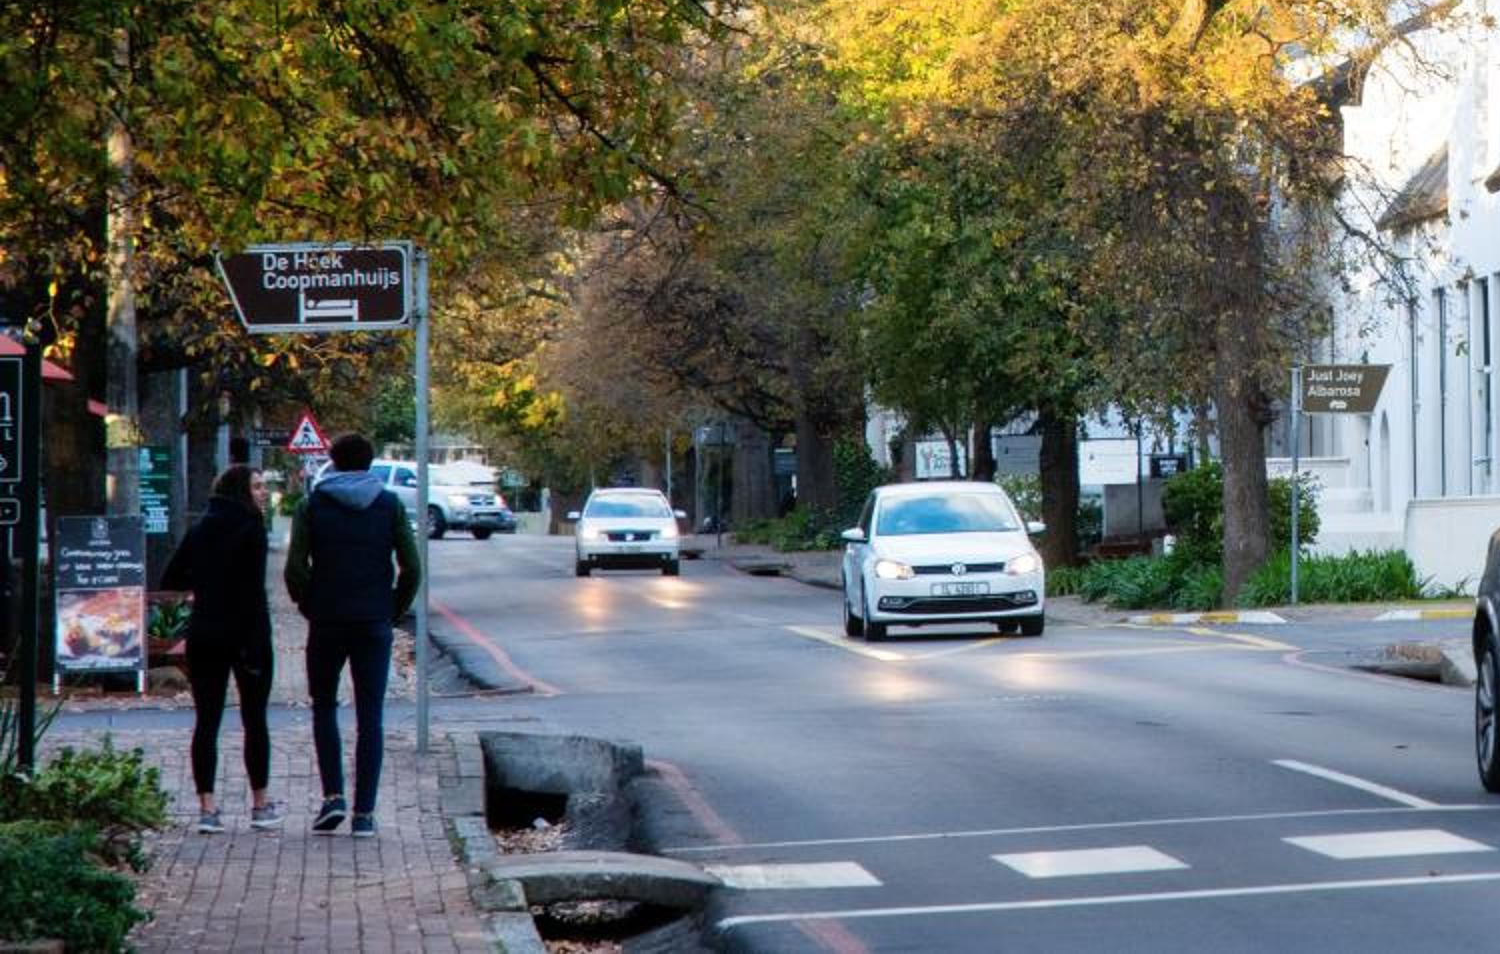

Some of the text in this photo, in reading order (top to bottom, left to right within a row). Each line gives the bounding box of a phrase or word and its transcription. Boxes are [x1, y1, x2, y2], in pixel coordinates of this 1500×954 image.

[263, 252, 344, 270] De Hoek
[263, 267, 400, 290] Coopmanhuijs
[1307, 369, 1363, 384] Just Joey
